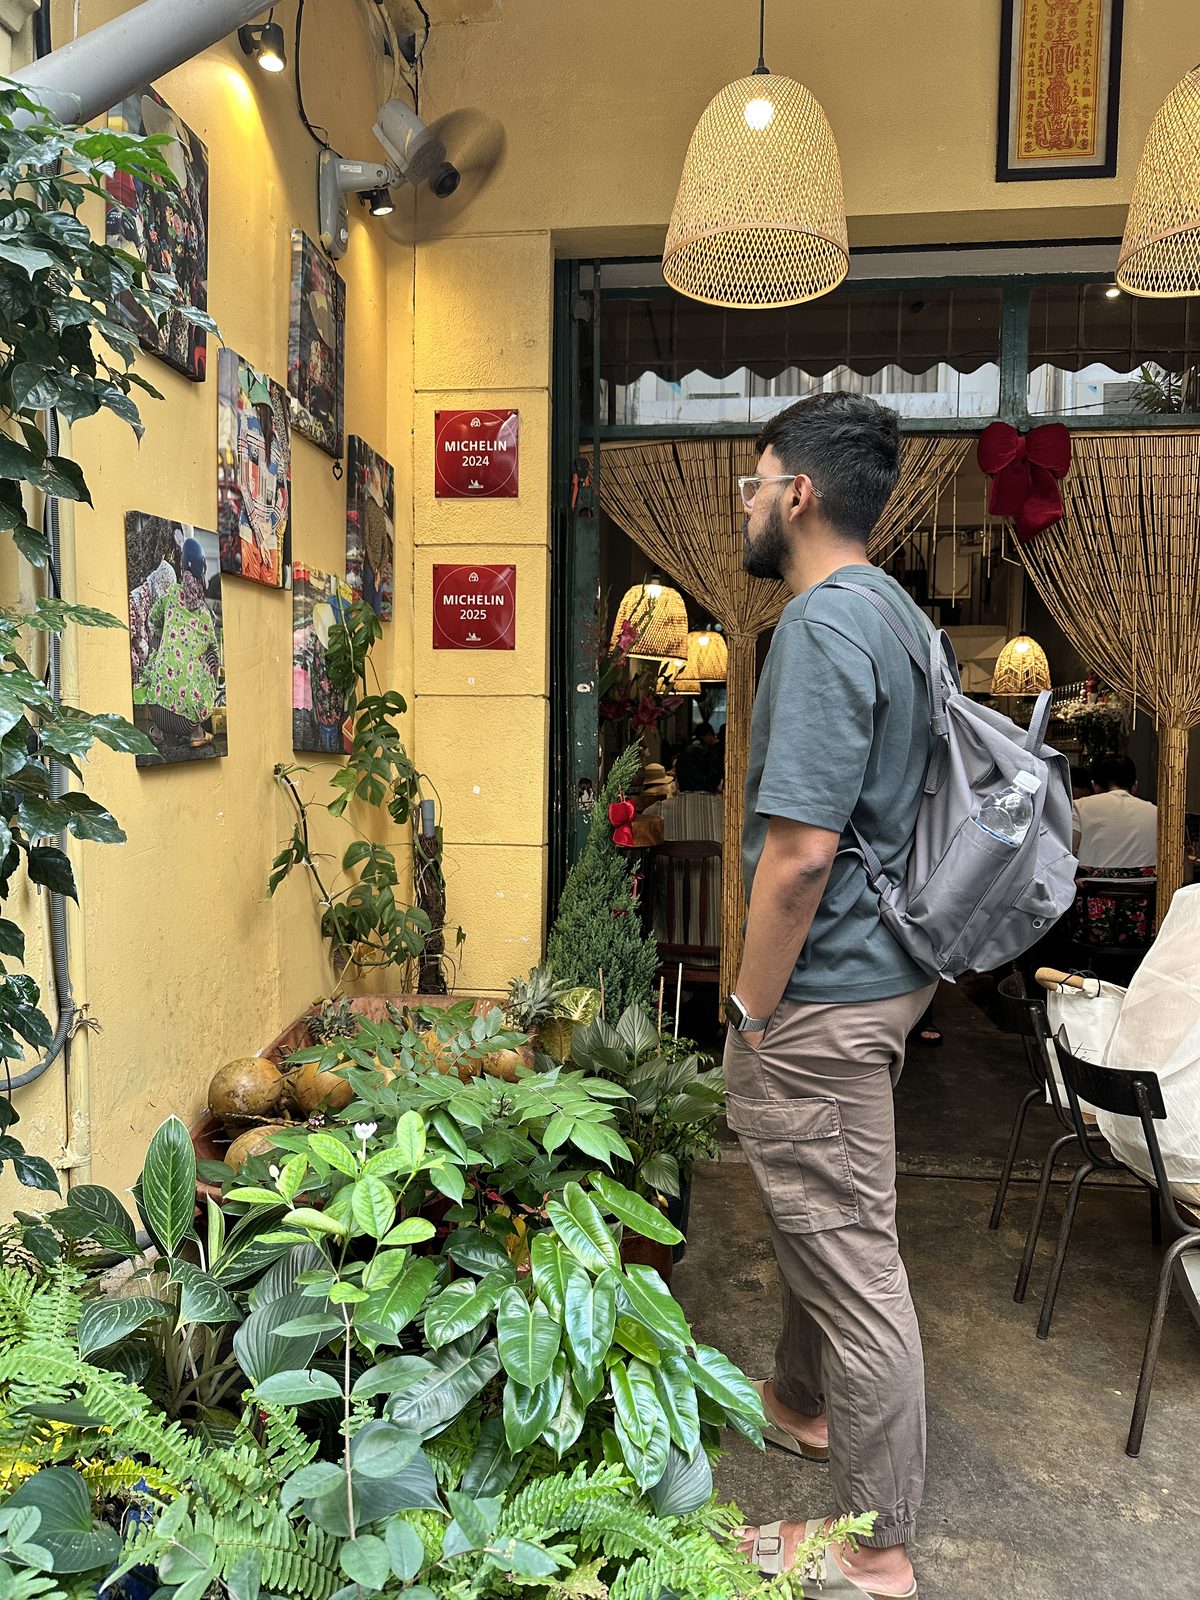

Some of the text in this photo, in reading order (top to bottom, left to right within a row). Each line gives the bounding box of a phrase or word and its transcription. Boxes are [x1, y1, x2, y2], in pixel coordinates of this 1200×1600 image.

[444, 440, 507, 452] MICHELIN
[461, 455, 490, 467] 2024
[443, 594, 505, 606] MICHELIN
[459, 609, 488, 620] 2025
